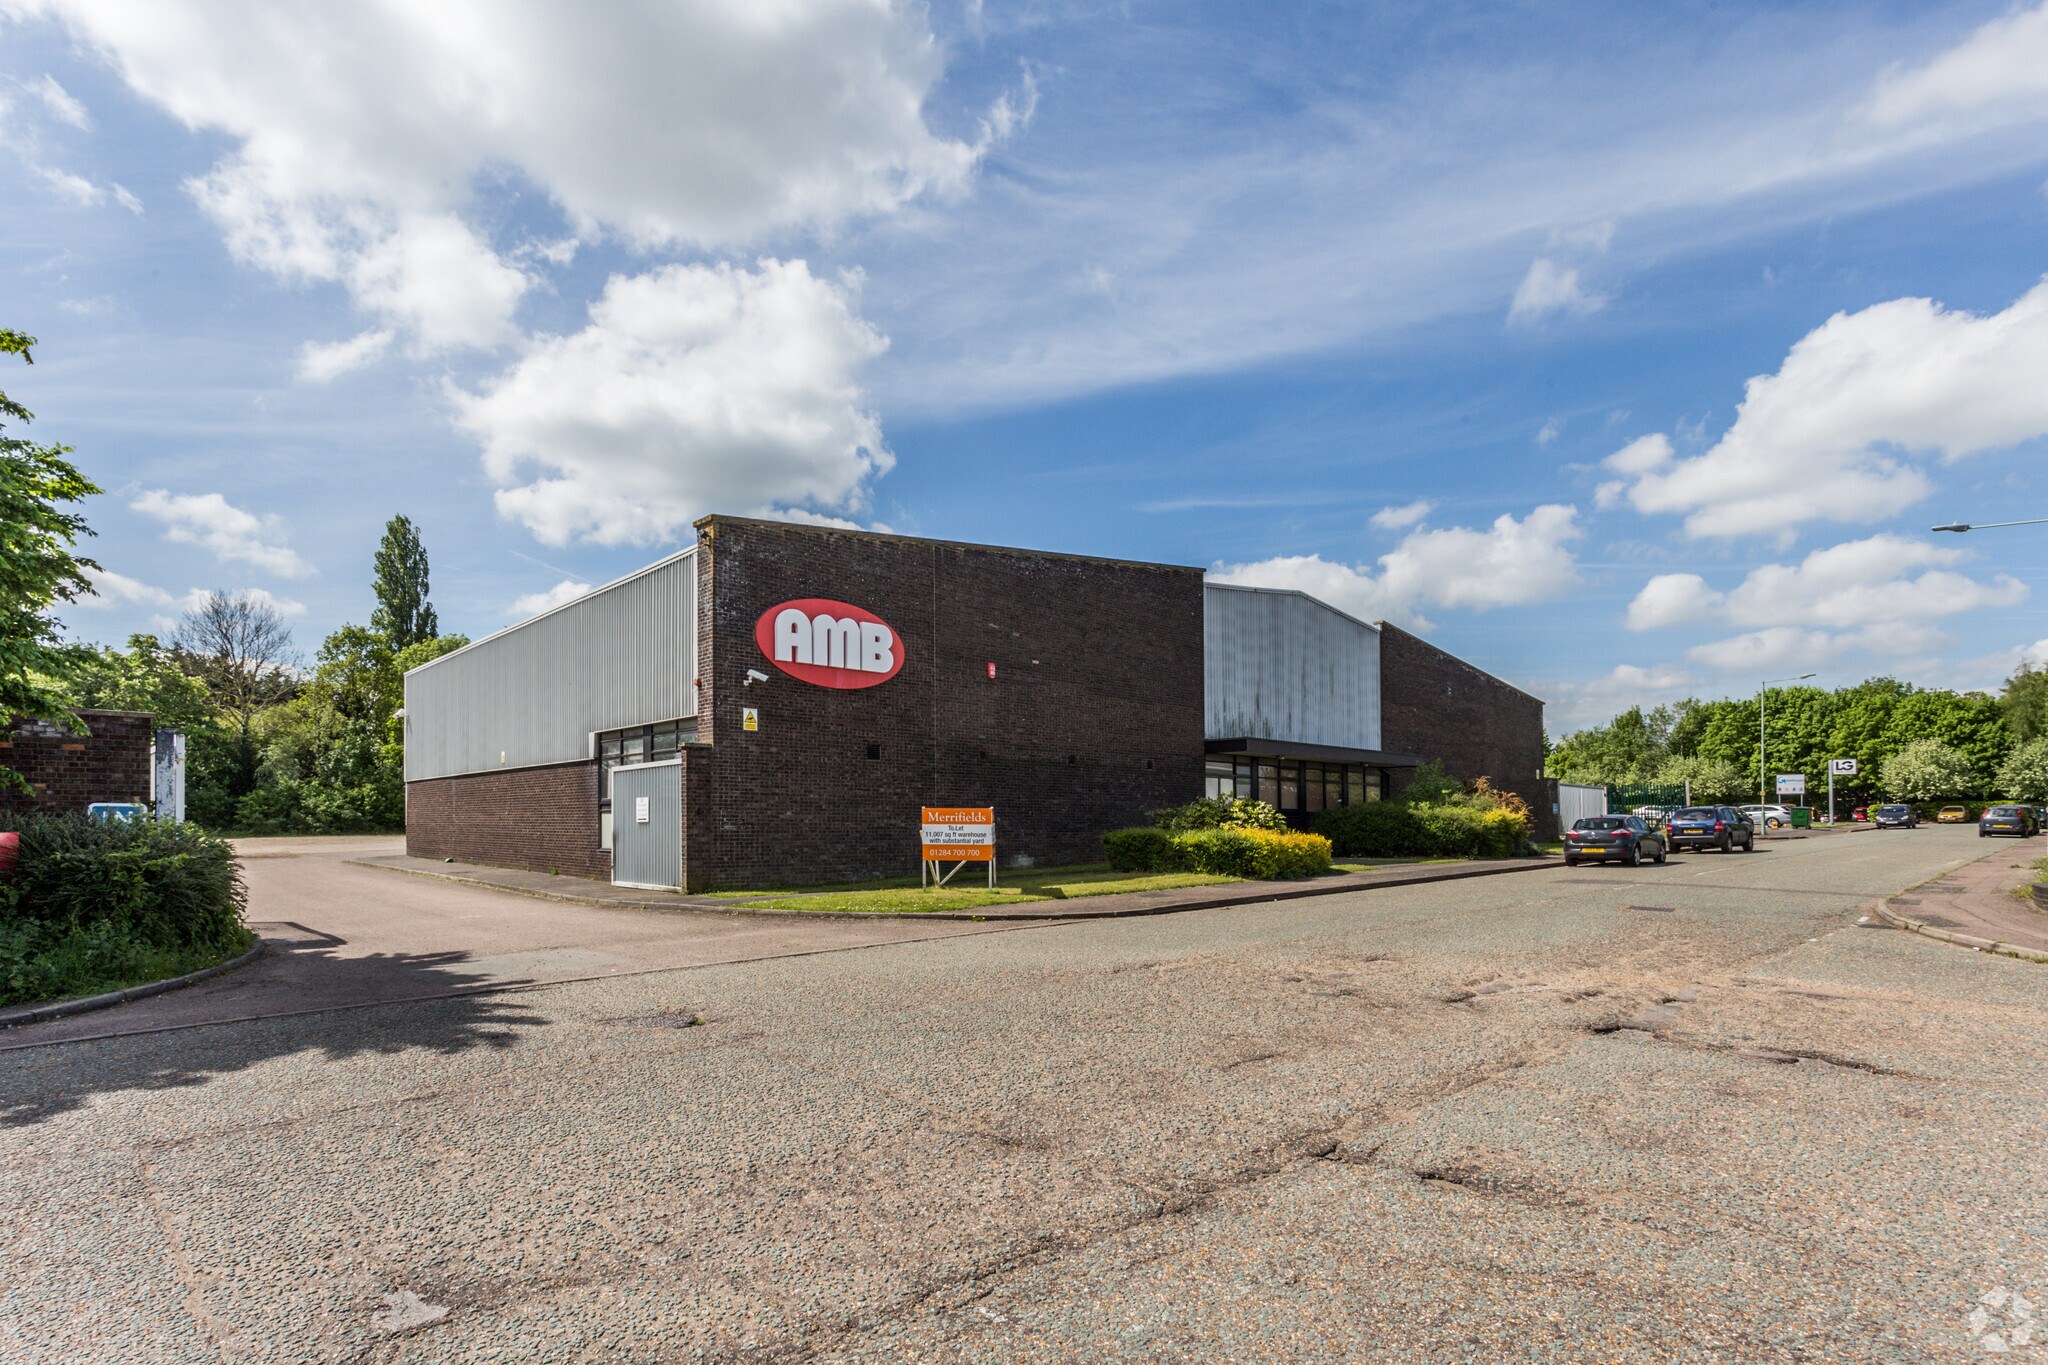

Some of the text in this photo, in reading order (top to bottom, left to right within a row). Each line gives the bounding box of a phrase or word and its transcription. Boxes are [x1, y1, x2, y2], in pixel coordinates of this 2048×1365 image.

[774, 608, 894, 674] AMB
[1835, 760, 1854, 771] LG
[927, 811, 986, 822] Merrifields
